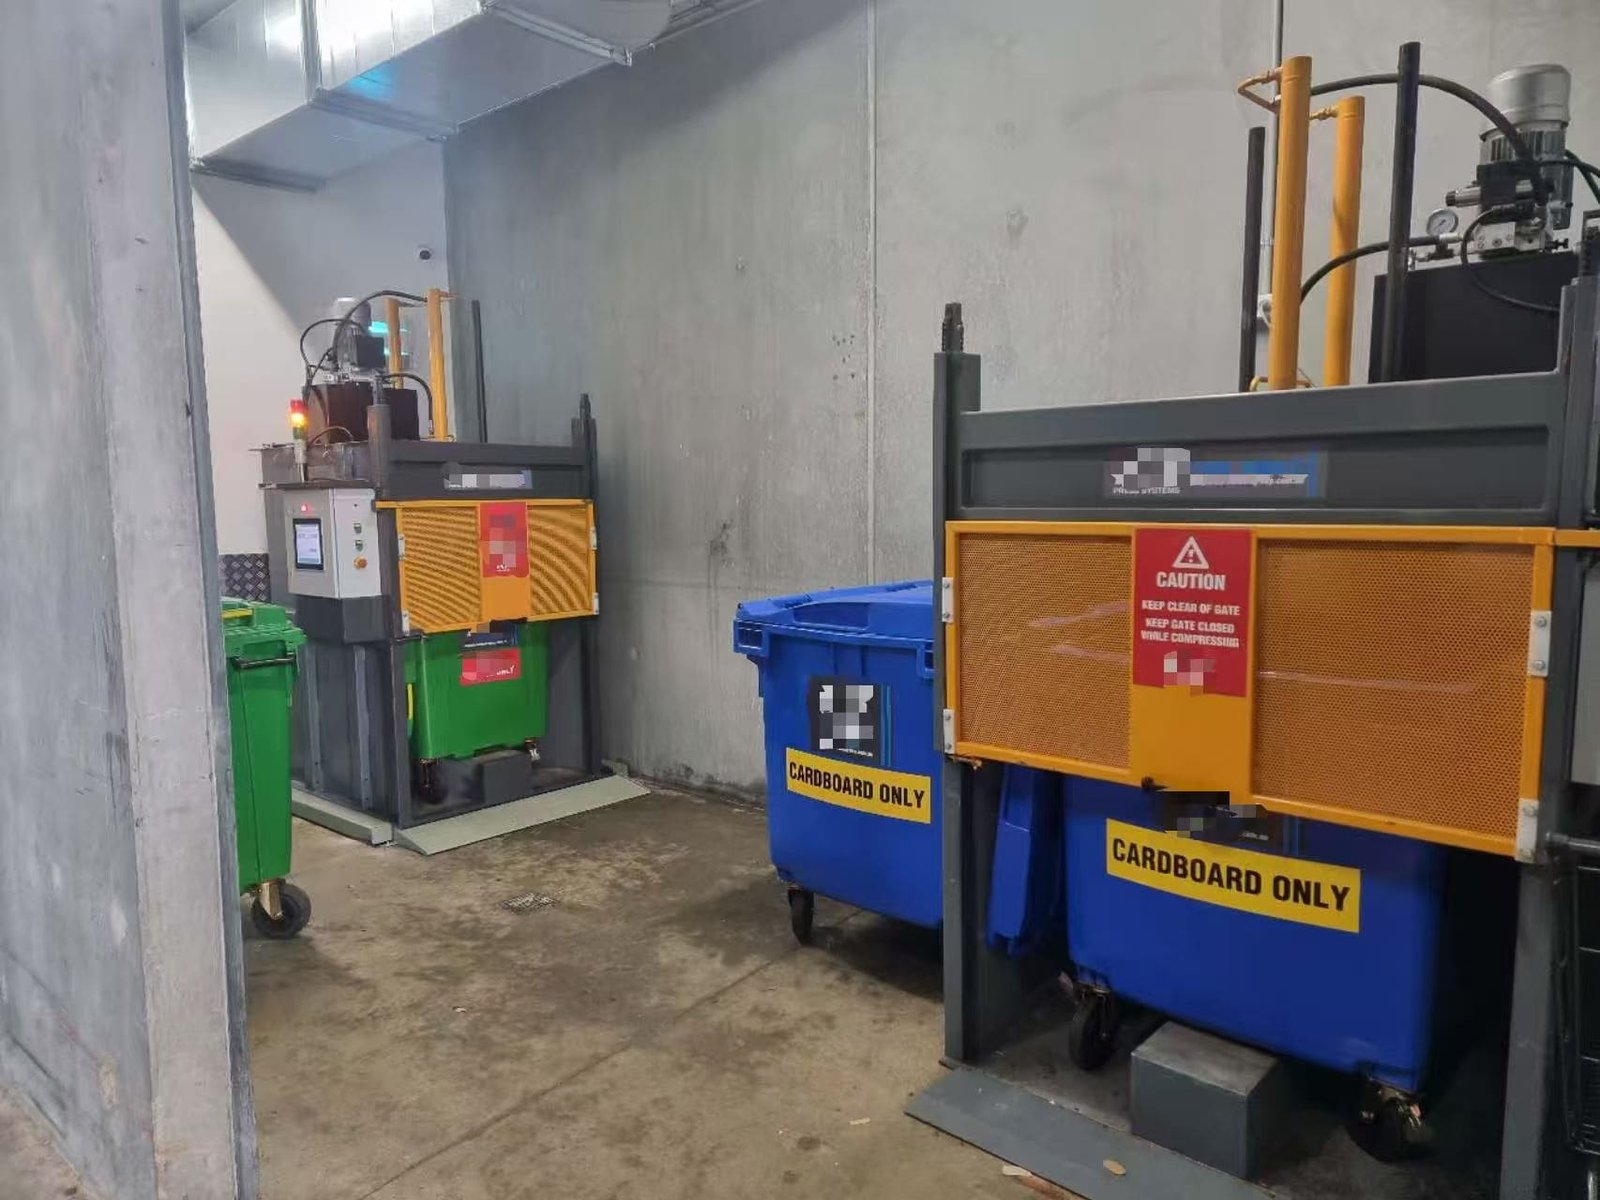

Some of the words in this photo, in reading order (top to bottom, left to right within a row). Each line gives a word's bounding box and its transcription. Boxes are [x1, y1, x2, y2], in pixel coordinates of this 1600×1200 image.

[1156, 571, 1226, 591] CAUTION
[1142, 600, 1166, 611] KEEP
[1167, 601, 1198, 613] CLEAR
[1200, 603, 1214, 614] OF
[1214, 604, 1240, 616] GATE
[1145, 618, 1169, 629] KEEP
[1171, 619, 1196, 631] GATE
[1197, 621, 1235, 634] CLOSED
[1140, 630, 1169, 641] WHILE
[1171, 632, 1240, 648] COMPRESSING
[789, 761, 874, 800] CARDBOARD
[879, 783, 926, 809] ONLY
[1113, 837, 1262, 896] CARDBOARD
[1272, 874, 1351, 912] ONLY
